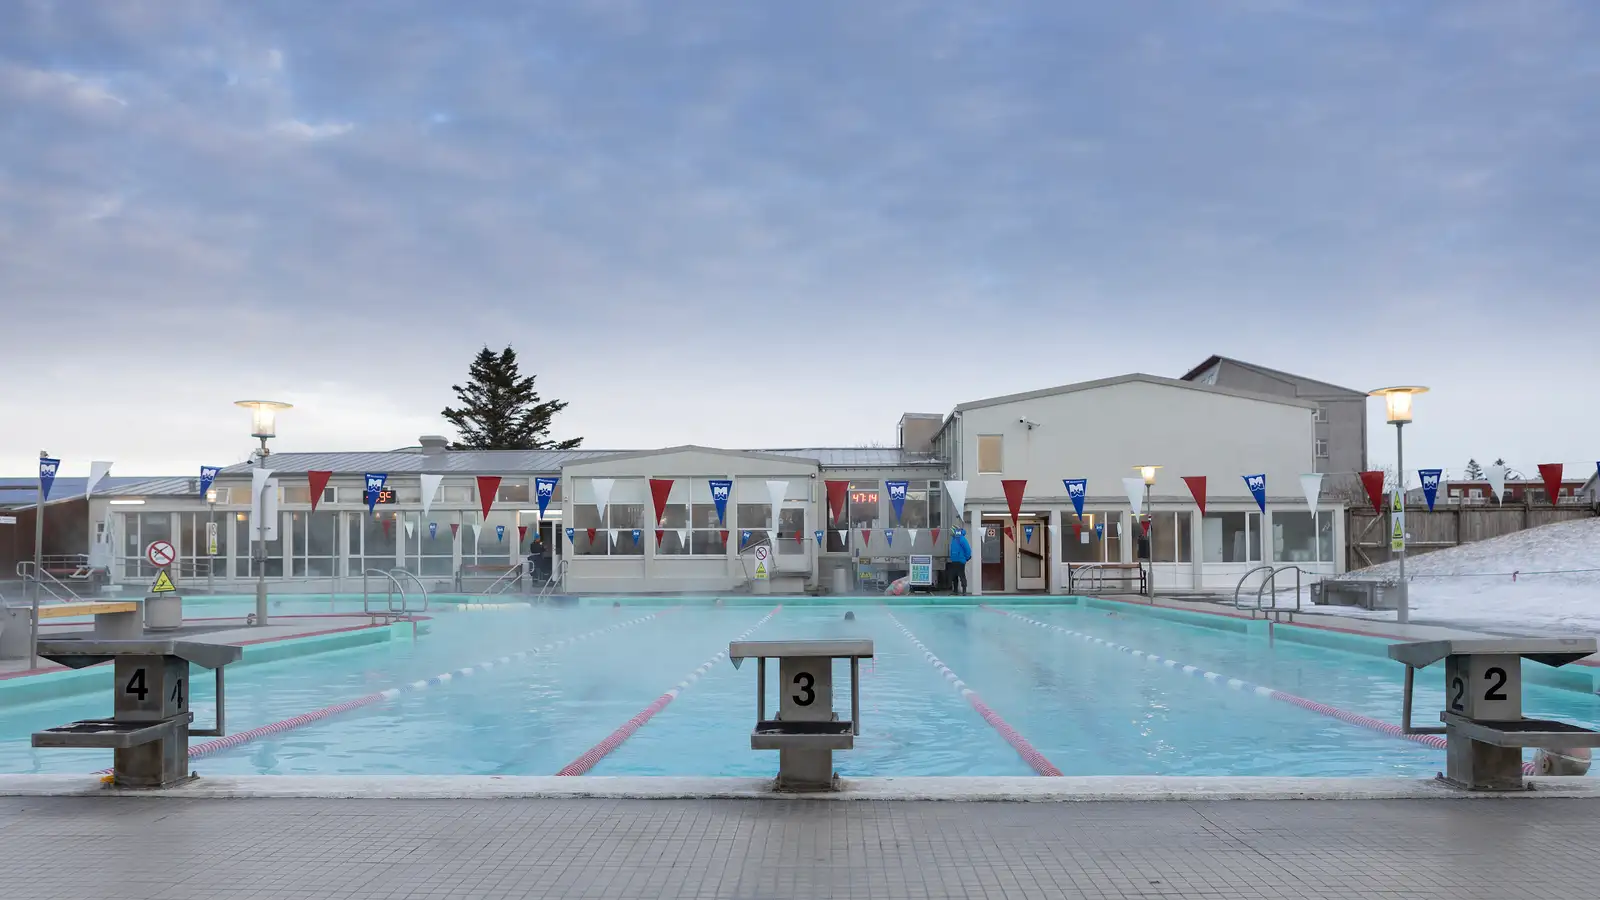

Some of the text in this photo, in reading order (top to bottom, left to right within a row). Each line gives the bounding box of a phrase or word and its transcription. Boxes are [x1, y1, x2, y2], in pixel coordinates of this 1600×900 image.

[852, 493, 877, 502] 47:14
[126, 668, 148, 700] 4
[793, 671, 815, 706] 3
[1451, 677, 1464, 711] 2
[1484, 667, 1507, 700] 2
